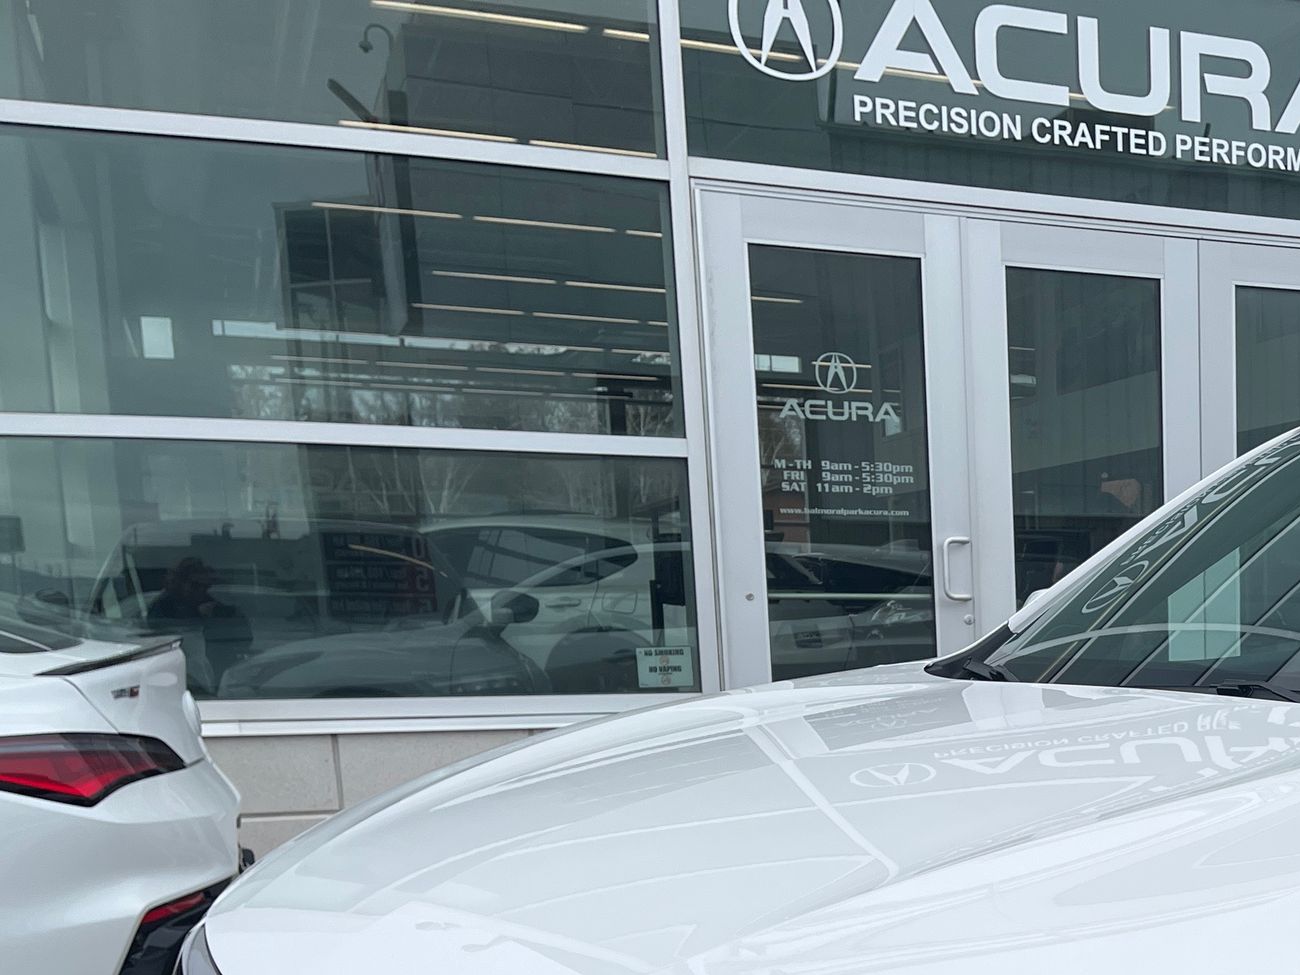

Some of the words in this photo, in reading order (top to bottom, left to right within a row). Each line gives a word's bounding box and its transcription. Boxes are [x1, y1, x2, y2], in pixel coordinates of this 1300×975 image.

[854, 95, 1022, 141] PRECISION
[1031, 116, 1168, 158] CRAFTED
[779, 398, 900, 422] ACURA
[783, 470, 805, 481] FRI
[781, 481, 807, 492] SAT
